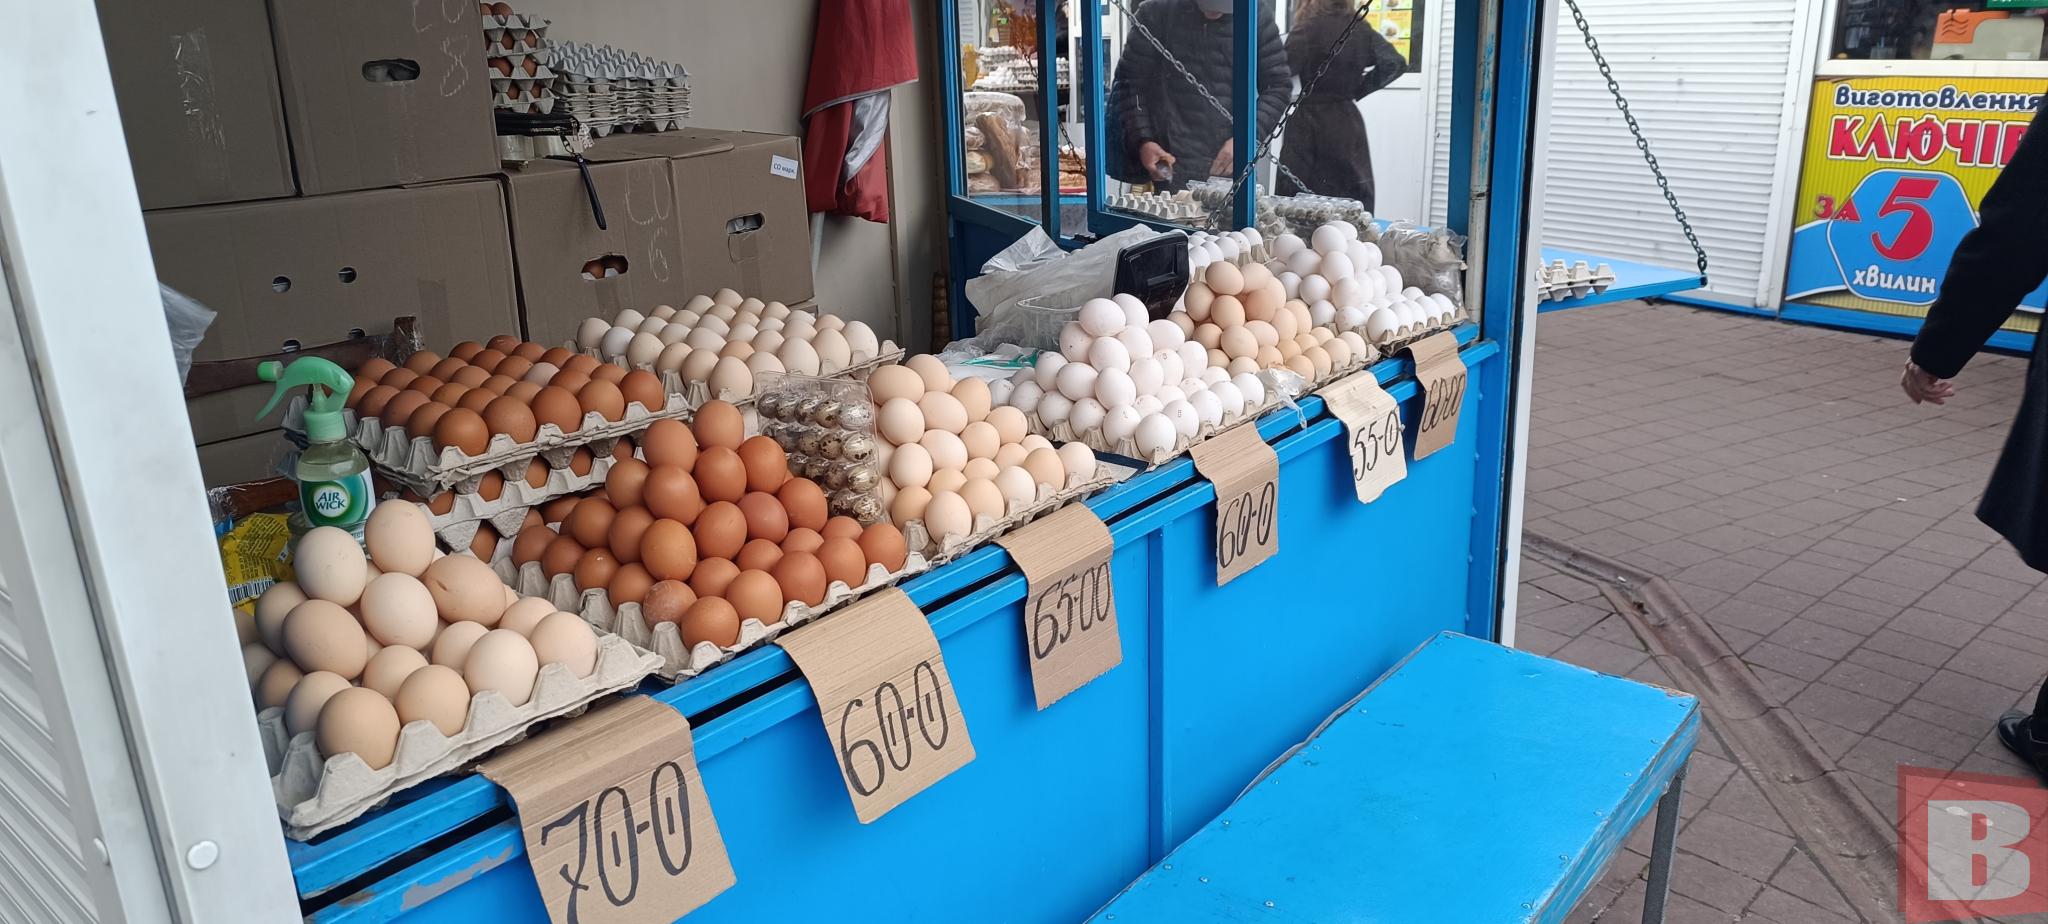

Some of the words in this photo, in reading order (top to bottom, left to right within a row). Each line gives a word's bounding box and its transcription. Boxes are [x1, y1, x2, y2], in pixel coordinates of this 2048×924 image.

[1871, 177, 1940, 261] 5
[1853, 265, 1936, 294] хвилин
[1353, 408, 1399, 482] 55-0
[315, 500, 346, 510] WICK
[318, 491, 341, 502] AIR
[1219, 481, 1275, 569] 60-0
[840, 660, 949, 797] 60-0
[540, 760, 694, 924] 70-0
